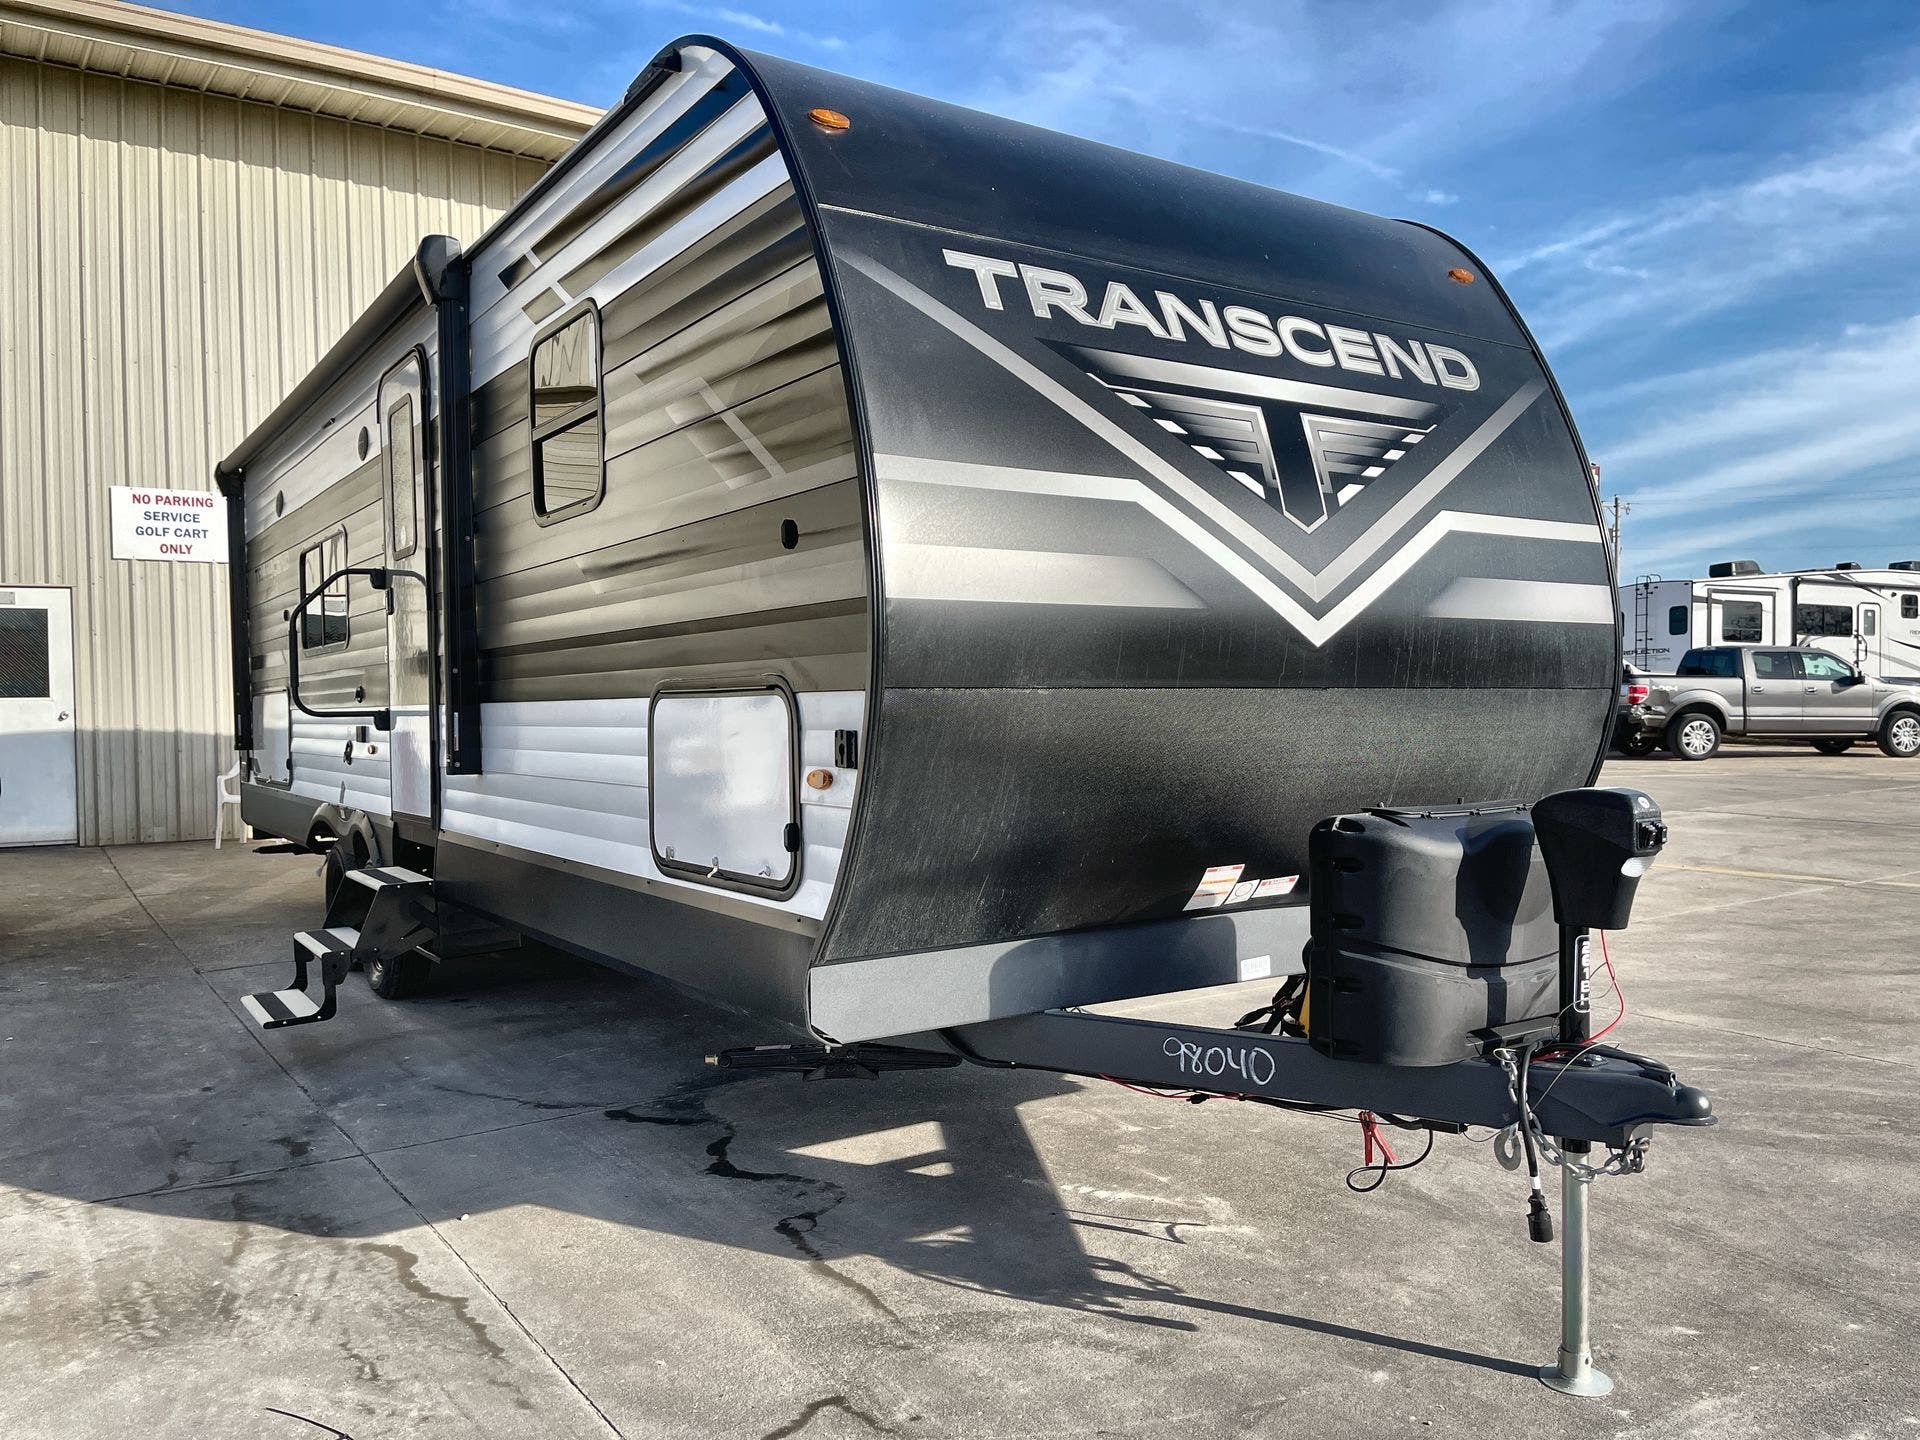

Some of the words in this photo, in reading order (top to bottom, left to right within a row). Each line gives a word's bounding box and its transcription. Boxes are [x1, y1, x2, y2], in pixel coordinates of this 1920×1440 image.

[942, 248, 1482, 391] TRANSCEND
[132, 494, 151, 505] NO
[155, 495, 214, 508] PARKING
[143, 511, 201, 523] SERVICE
[135, 526, 170, 537] GOLF
[174, 528, 209, 539] CART
[160, 543, 193, 555] ONLY
[1163, 1036, 1277, 1086] 98040
